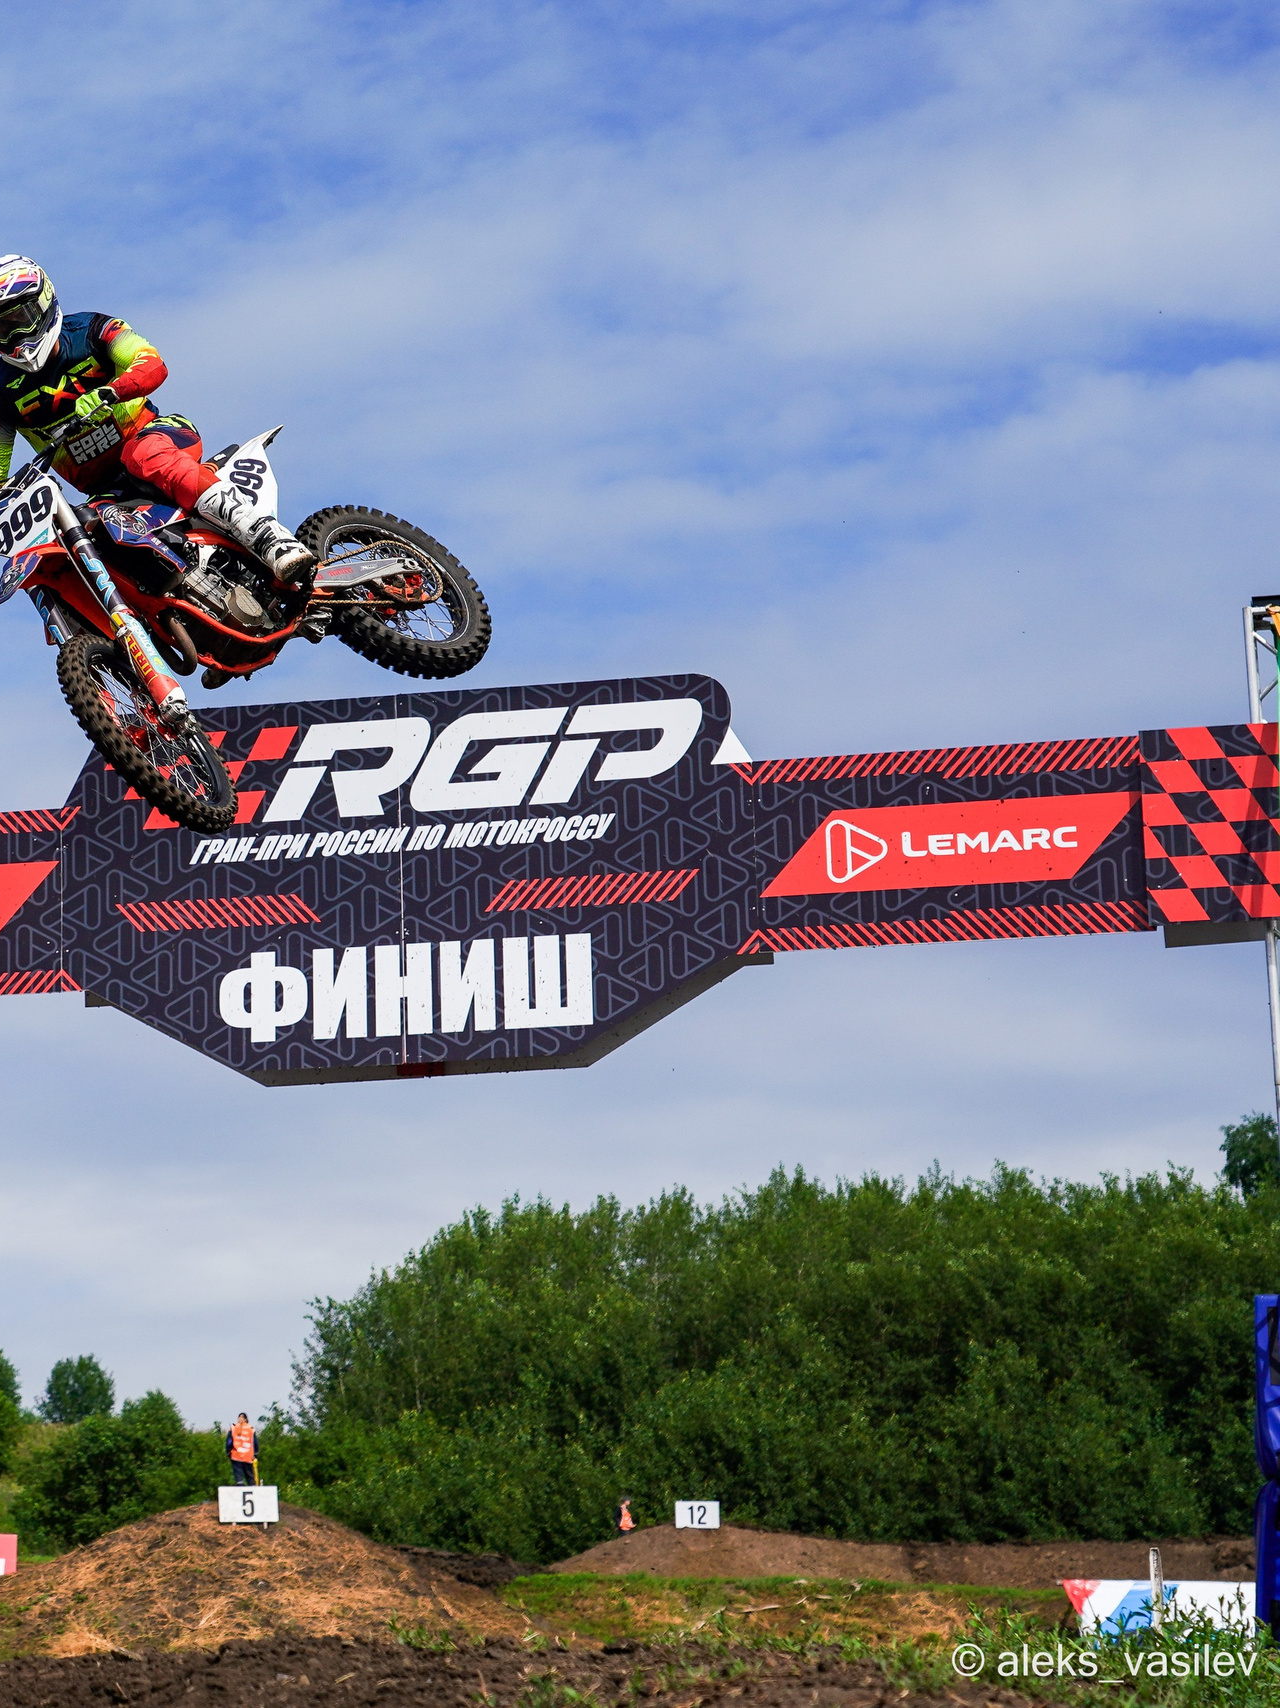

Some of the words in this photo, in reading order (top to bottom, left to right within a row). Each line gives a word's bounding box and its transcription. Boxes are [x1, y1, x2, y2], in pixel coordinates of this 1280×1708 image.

[15, 356, 106, 424] FXR
[69, 422, 115, 456] COOL
[74, 432, 121, 465] MTRS
[264, 698, 703, 823] RGP
[189, 832, 307, 866] ГРАН-ПРИ
[306, 825, 406, 859] РОССИИ
[400, 822, 445, 852] ПО
[446, 813, 616, 849] МОТОКРОССУ
[218, 932, 594, 1043] ФИНИШ
[242, 1491, 255, 1518] 5
[687, 1504, 707, 1526] 12
